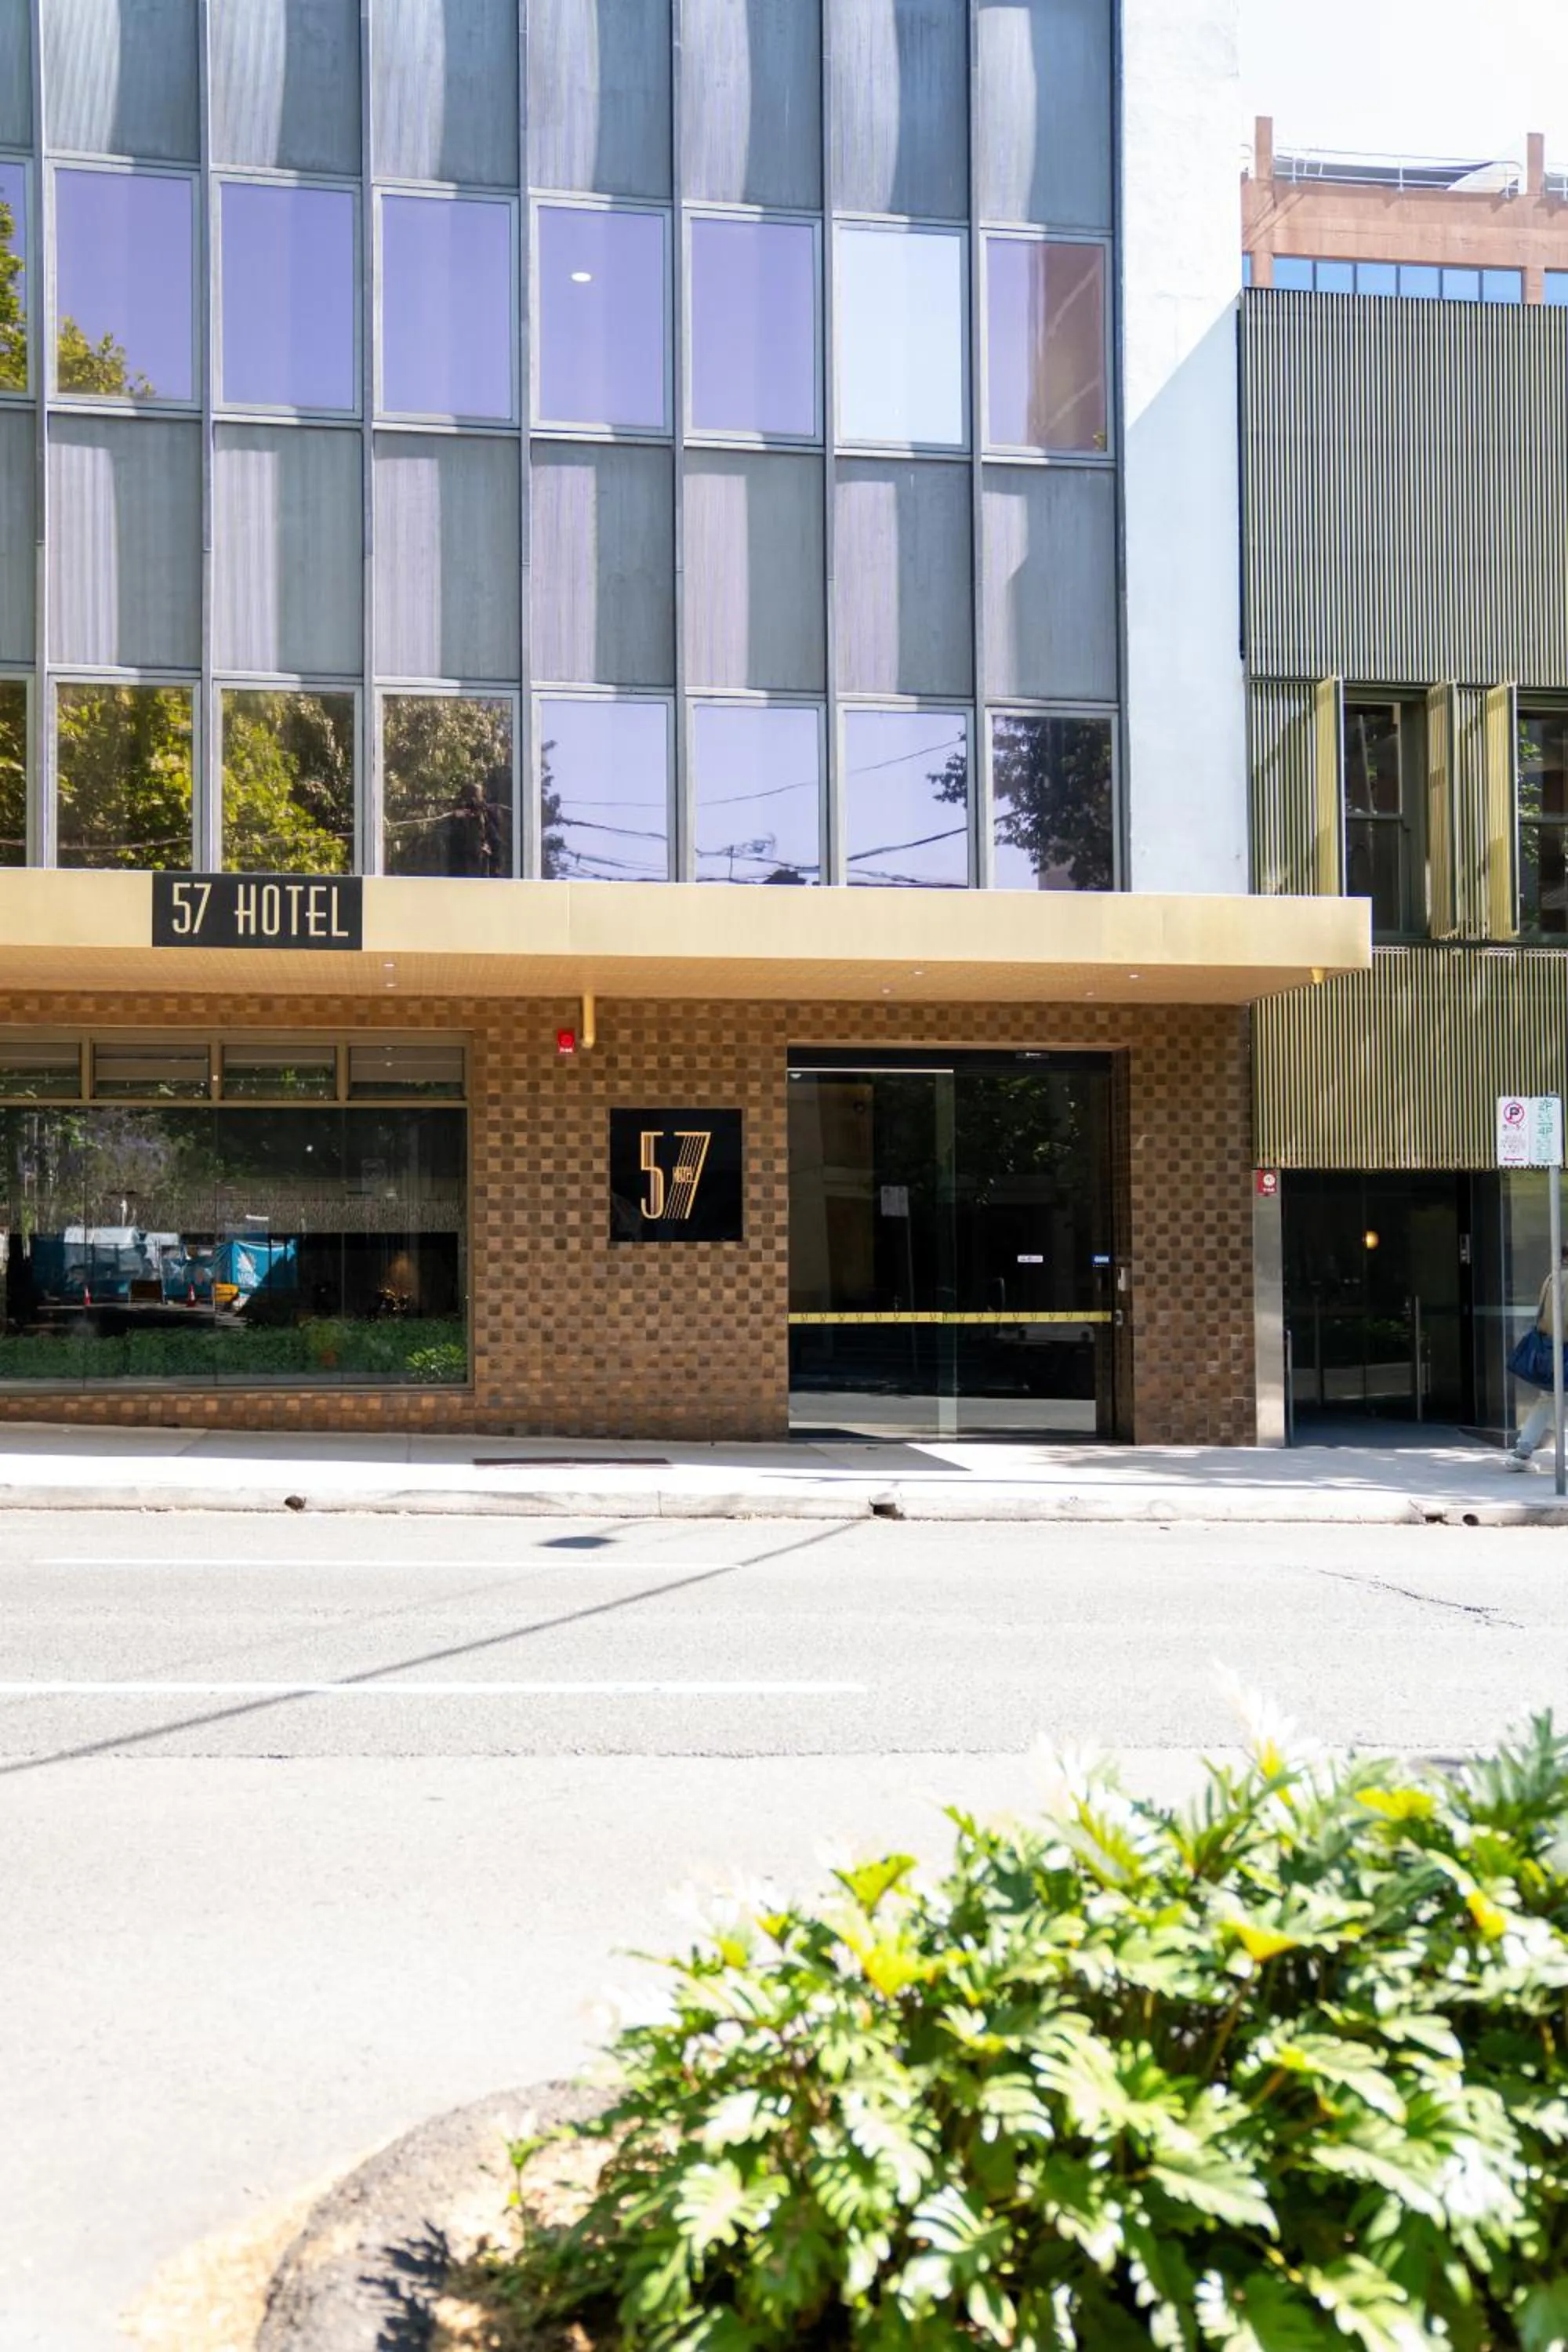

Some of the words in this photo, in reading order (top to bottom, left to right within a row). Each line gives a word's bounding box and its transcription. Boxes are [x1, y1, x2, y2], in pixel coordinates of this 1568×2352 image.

[172, 882, 212, 934] 57
[234, 884, 349, 937] HOTEL
[1509, 1106, 1520, 1120] P
[641, 1131, 711, 1219] 57
